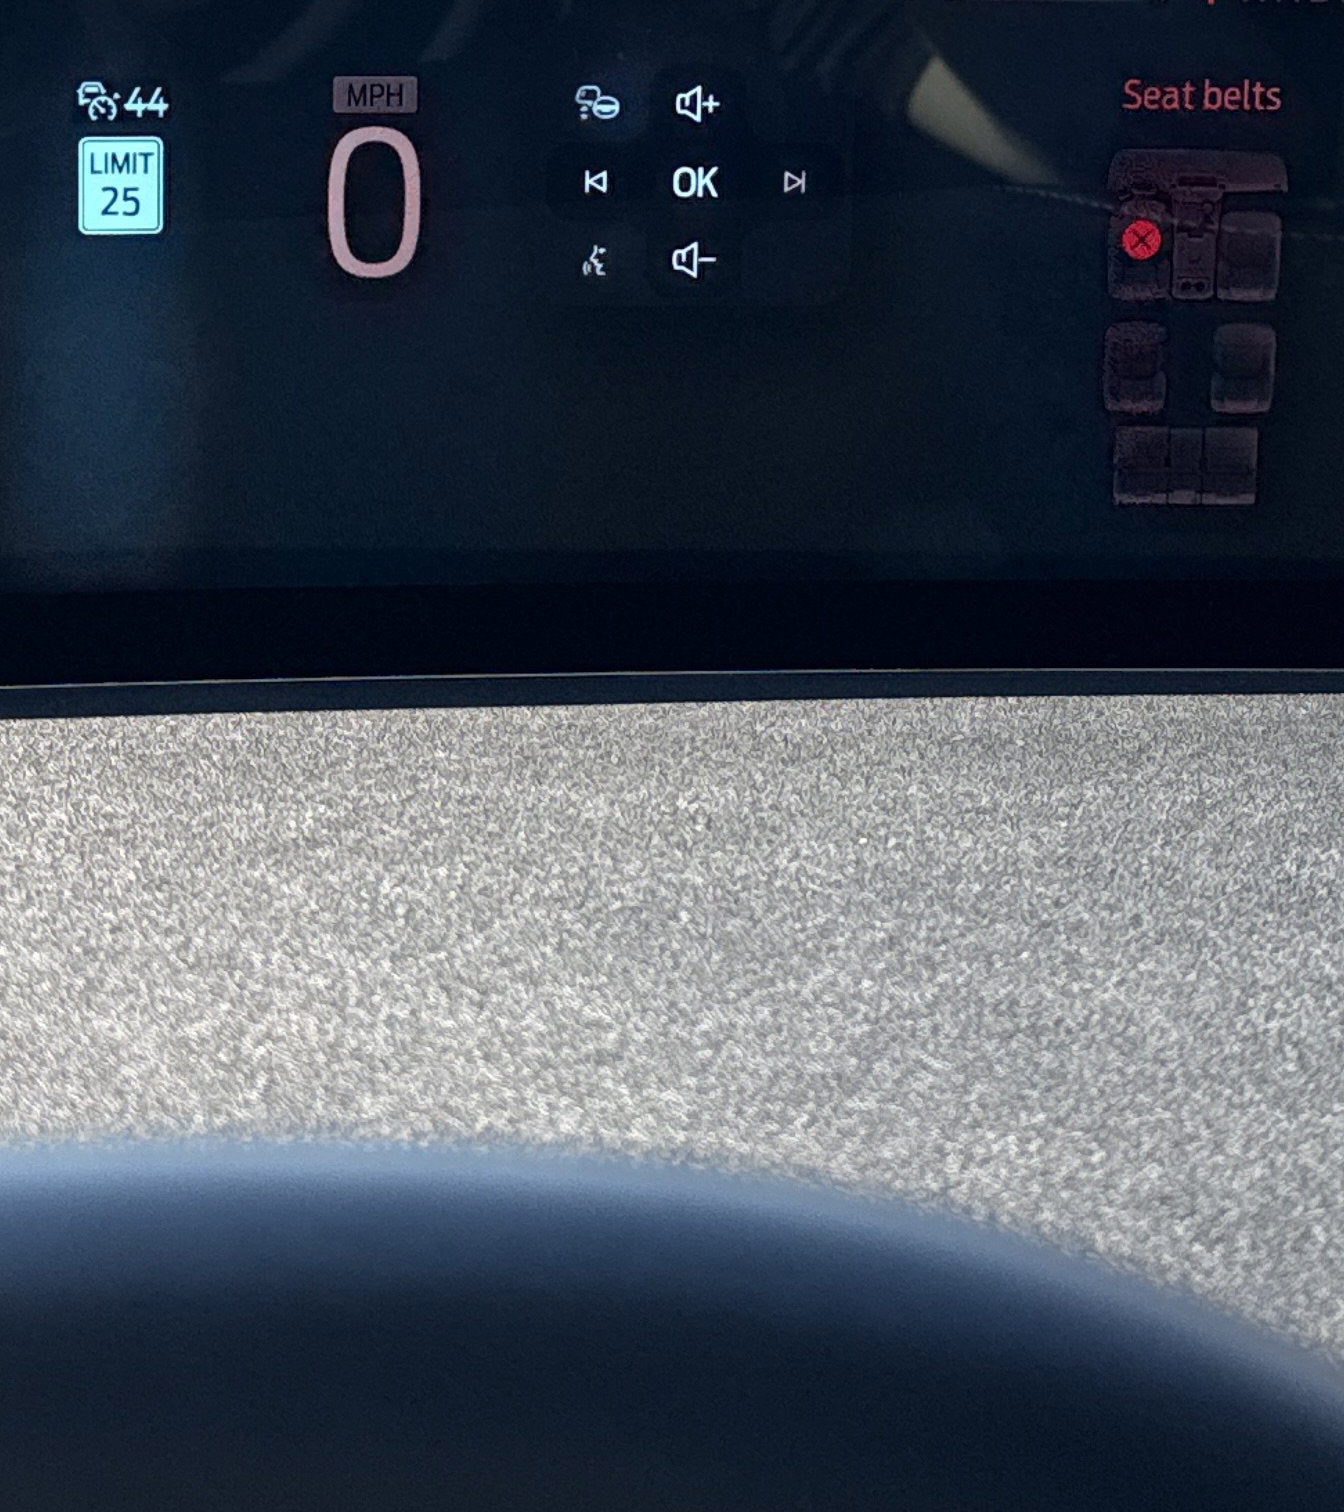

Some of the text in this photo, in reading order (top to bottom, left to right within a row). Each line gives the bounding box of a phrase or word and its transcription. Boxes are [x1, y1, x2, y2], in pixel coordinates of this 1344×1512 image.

[123, 86, 169, 119] 44
[346, 83, 404, 107] MPH
[1123, 79, 1282, 111] Seat belts
[90, 152, 154, 175] LIMIT
[672, 166, 719, 199] OK
[100, 186, 141, 217] 25
[327, 125, 421, 278] 0
